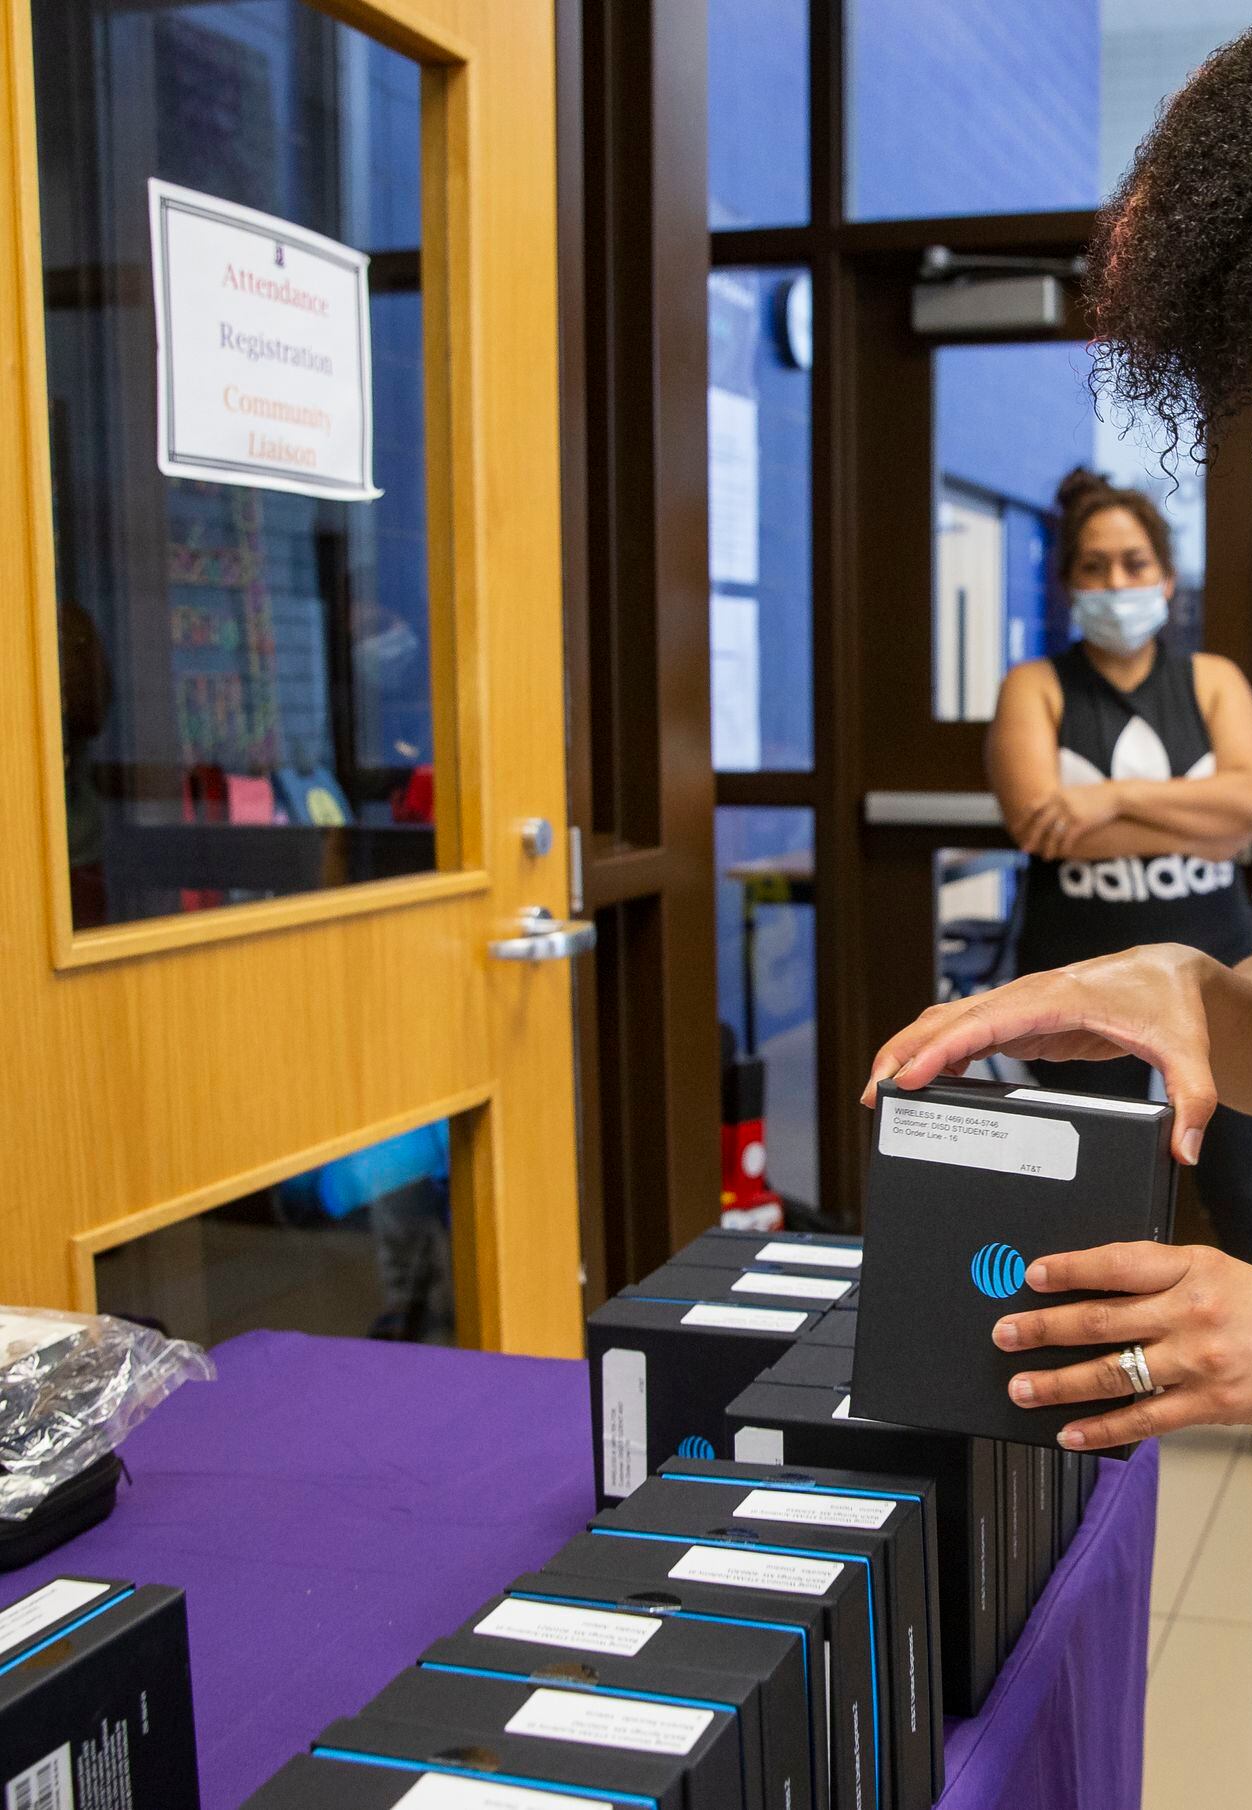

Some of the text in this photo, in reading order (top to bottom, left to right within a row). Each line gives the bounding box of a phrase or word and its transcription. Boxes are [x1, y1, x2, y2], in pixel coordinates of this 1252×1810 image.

[221, 263, 331, 317] Attendance
[218, 321, 334, 377] Registration
[222, 384, 333, 438] Community
[247, 430, 318, 468] Liaison
[894, 1107, 936, 1120] WIRELESS
[892, 1126, 904, 1135] On
[904, 1128, 926, 1138] Order
[927, 1132, 943, 1140] Line
[931, 1122, 951, 1132] DISD
[951, 1125, 990, 1137] STUDENT
[1020, 1164, 1043, 1174] AT&T
